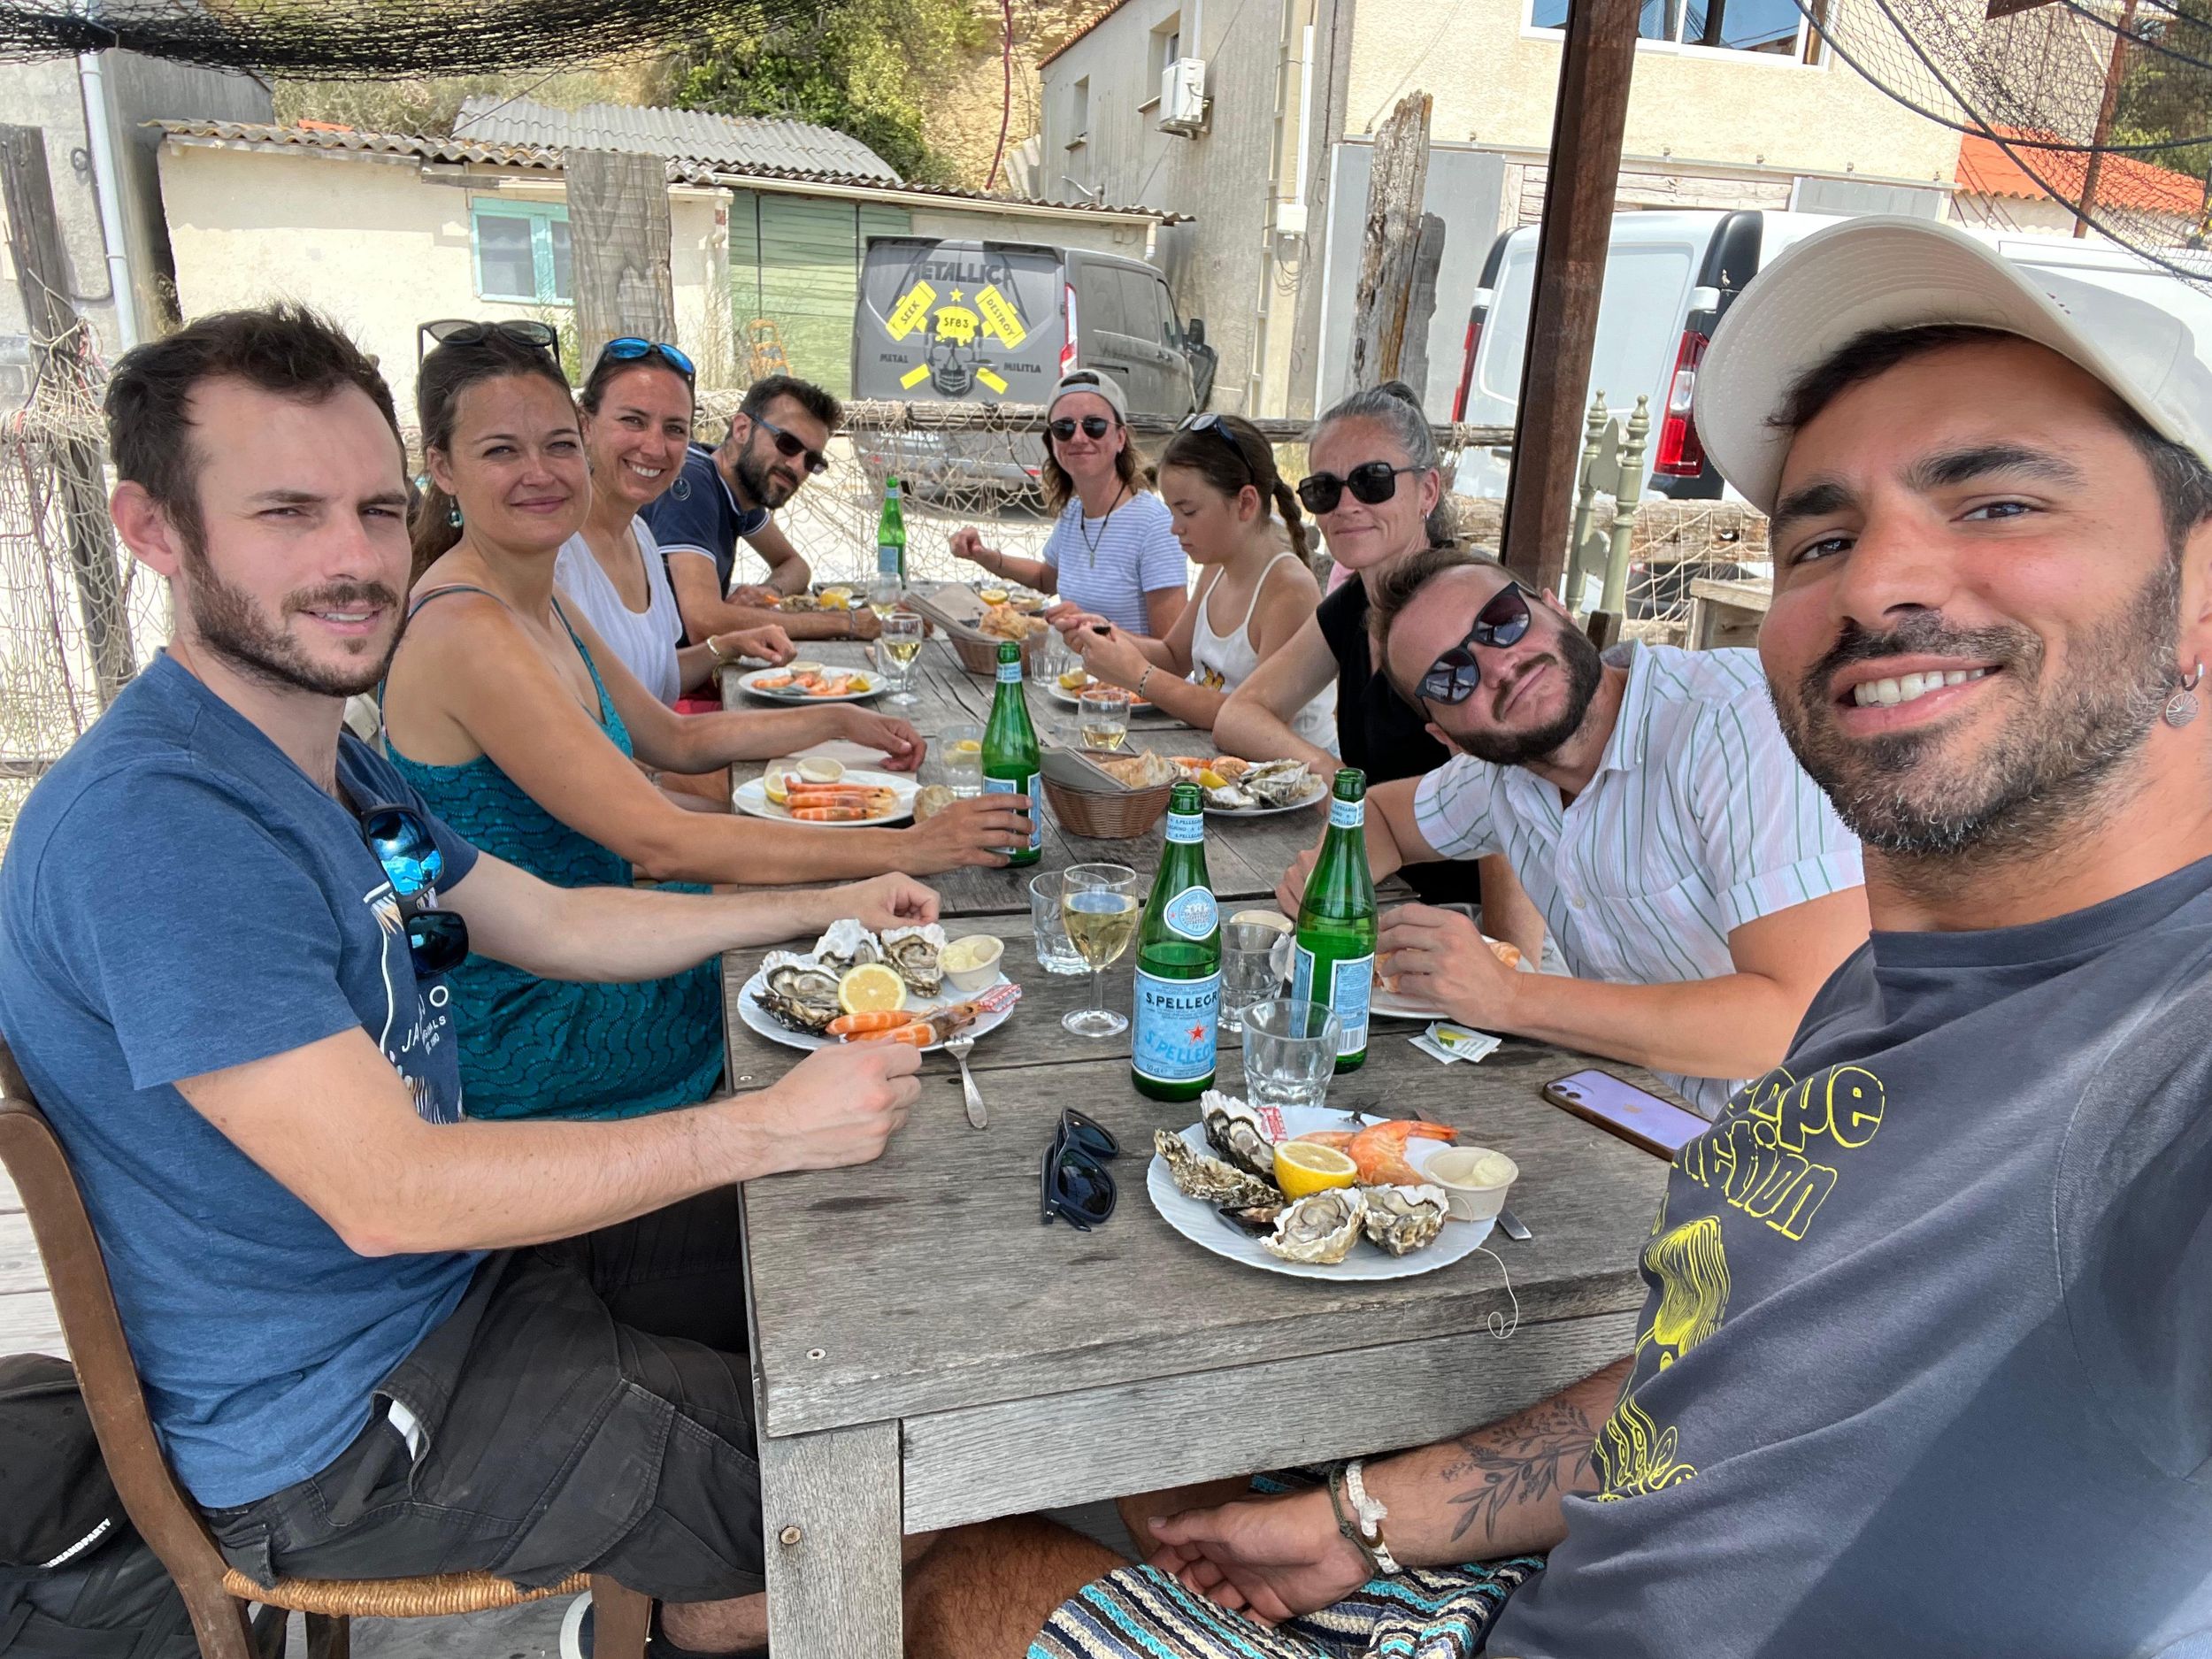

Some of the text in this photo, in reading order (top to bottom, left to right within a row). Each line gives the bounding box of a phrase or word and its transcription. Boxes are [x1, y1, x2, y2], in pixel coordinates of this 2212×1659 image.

[901, 300, 920, 325] SEEK
[986, 298, 1016, 336] DESTROY
[879, 353, 910, 365] METAL
[1003, 361, 1041, 373] MILITIA
